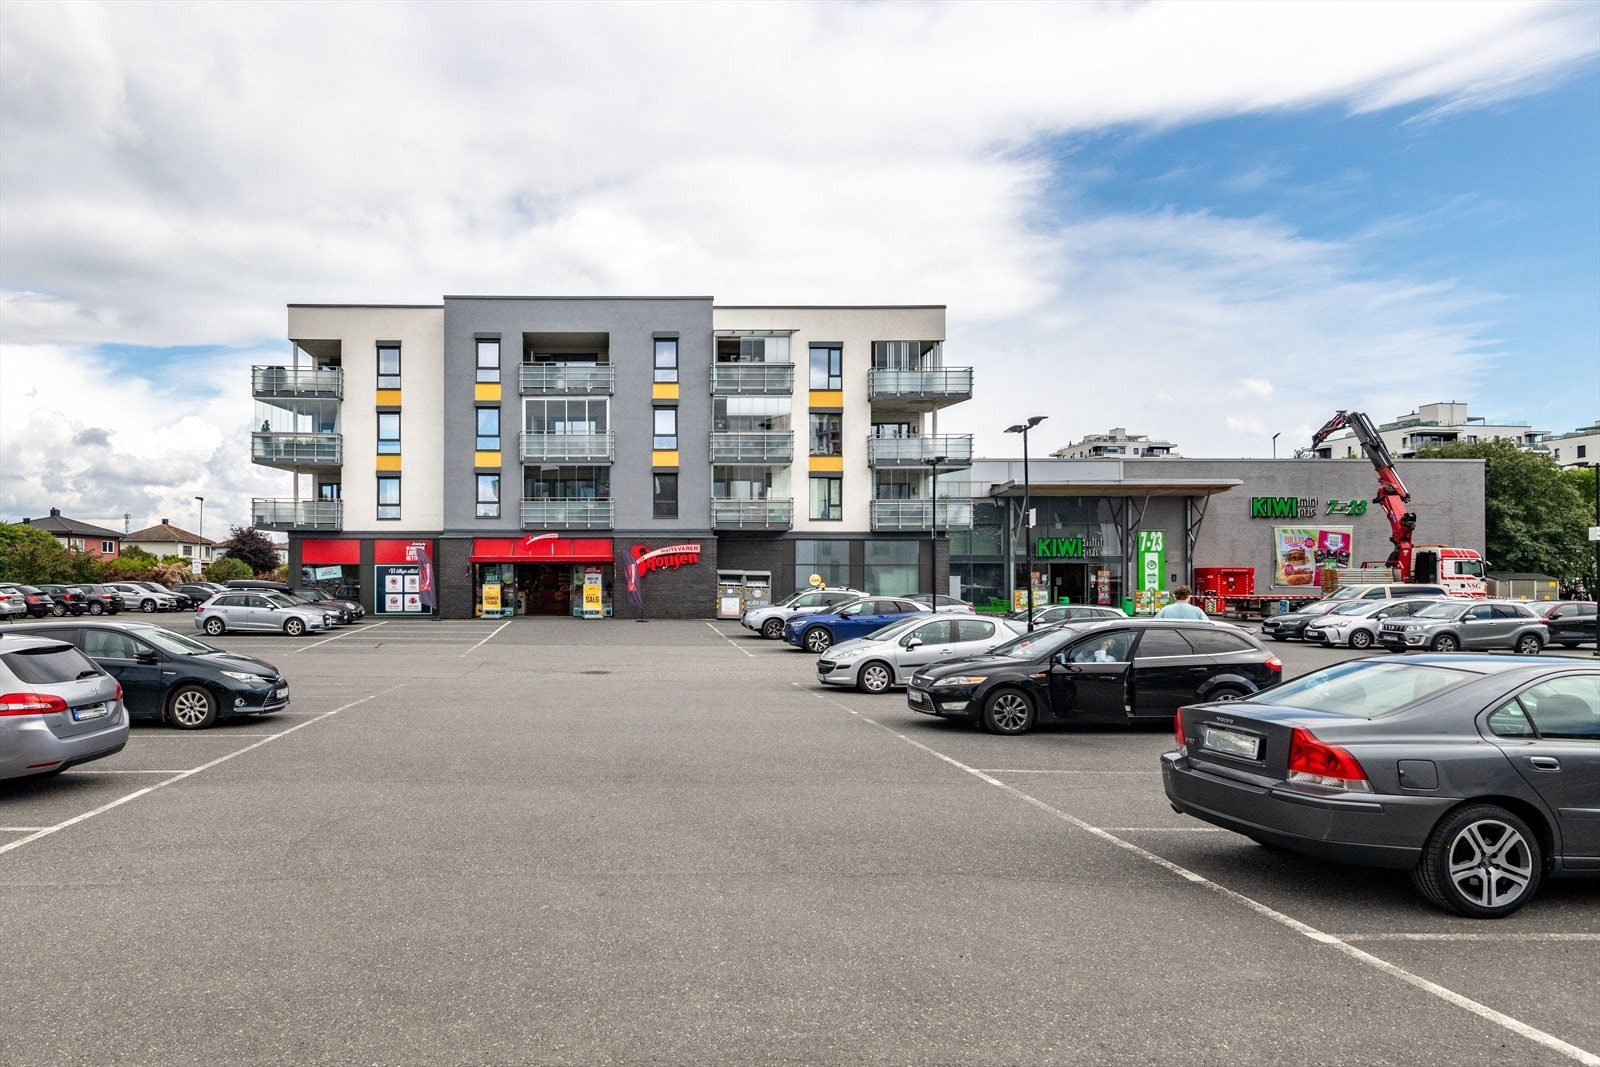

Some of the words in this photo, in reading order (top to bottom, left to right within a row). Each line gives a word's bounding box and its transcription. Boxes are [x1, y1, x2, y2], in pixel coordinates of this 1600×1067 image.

[1299, 497, 1319, 506] mini
[1252, 497, 1298, 518] KIWI
[1298, 507, 1317, 518] pris
[1083, 537, 1104, 547] mini
[1140, 531, 1163, 552] 7-23
[660, 545, 699, 554] HVITEVARER
[1037, 537, 1083, 558] KIWI
[1083, 547, 1103, 559] pris
[1216, 716, 1234, 724] VOLVO
